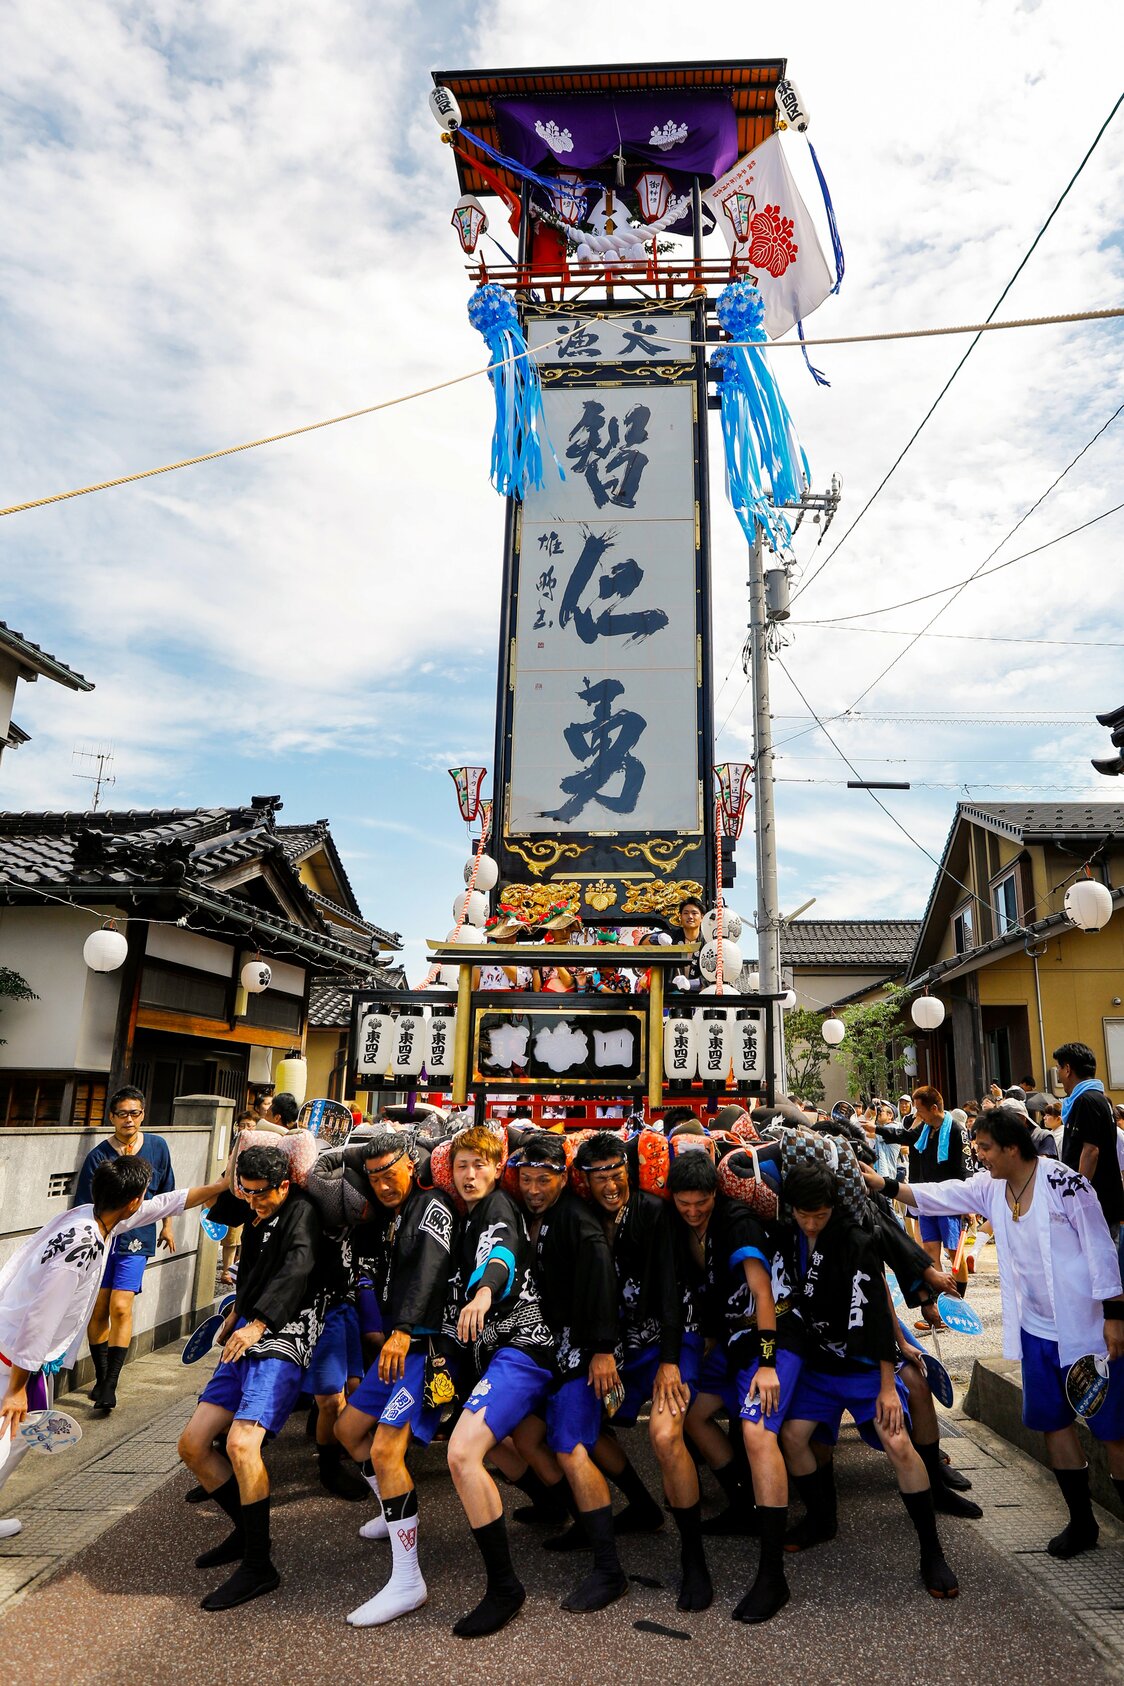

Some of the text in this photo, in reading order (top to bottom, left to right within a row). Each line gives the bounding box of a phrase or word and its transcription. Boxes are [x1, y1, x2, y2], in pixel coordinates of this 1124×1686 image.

[432, 87, 455, 115] 東四区
[777, 80, 803, 122] 東四区
[363, 1030, 382, 1064] 東四区
[397, 1031, 414, 1066] 東四区
[431, 1032, 447, 1066] 東四区
[673, 1035, 689, 1070] 東四区
[708, 1036, 723, 1071] 東四区
[742, 1037, 757, 1072] 東四区
[803, 1251, 824, 1298] 智仁勇
